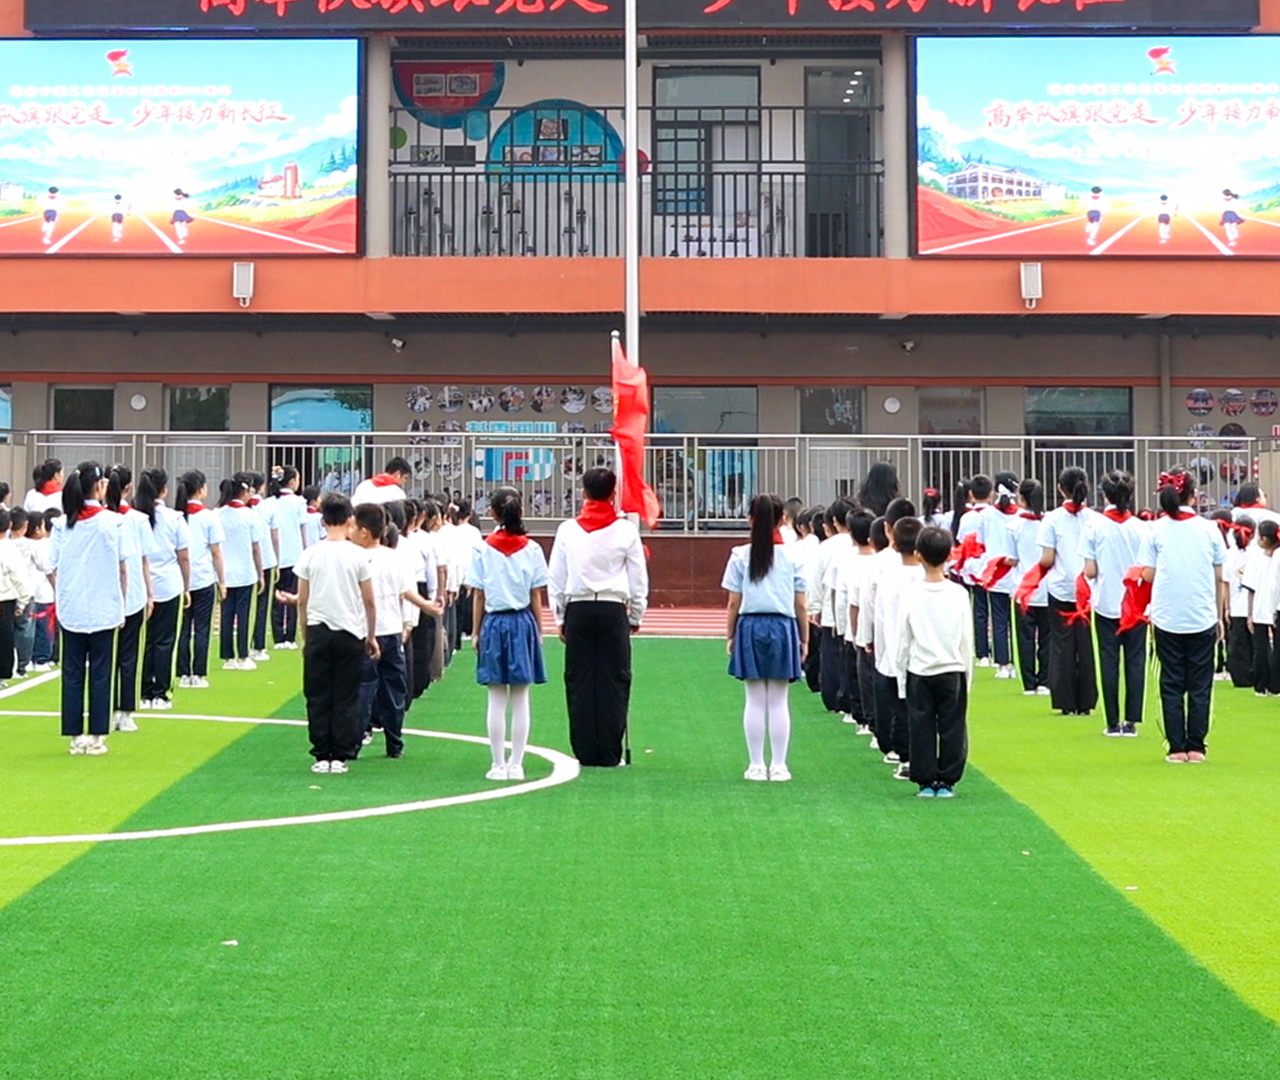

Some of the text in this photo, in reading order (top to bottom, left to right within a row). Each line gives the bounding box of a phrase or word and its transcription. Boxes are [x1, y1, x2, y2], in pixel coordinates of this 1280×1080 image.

[132, 103, 289, 128] 少年接力新长征
[986, 102, 1159, 128] 高举队旗跟党走
